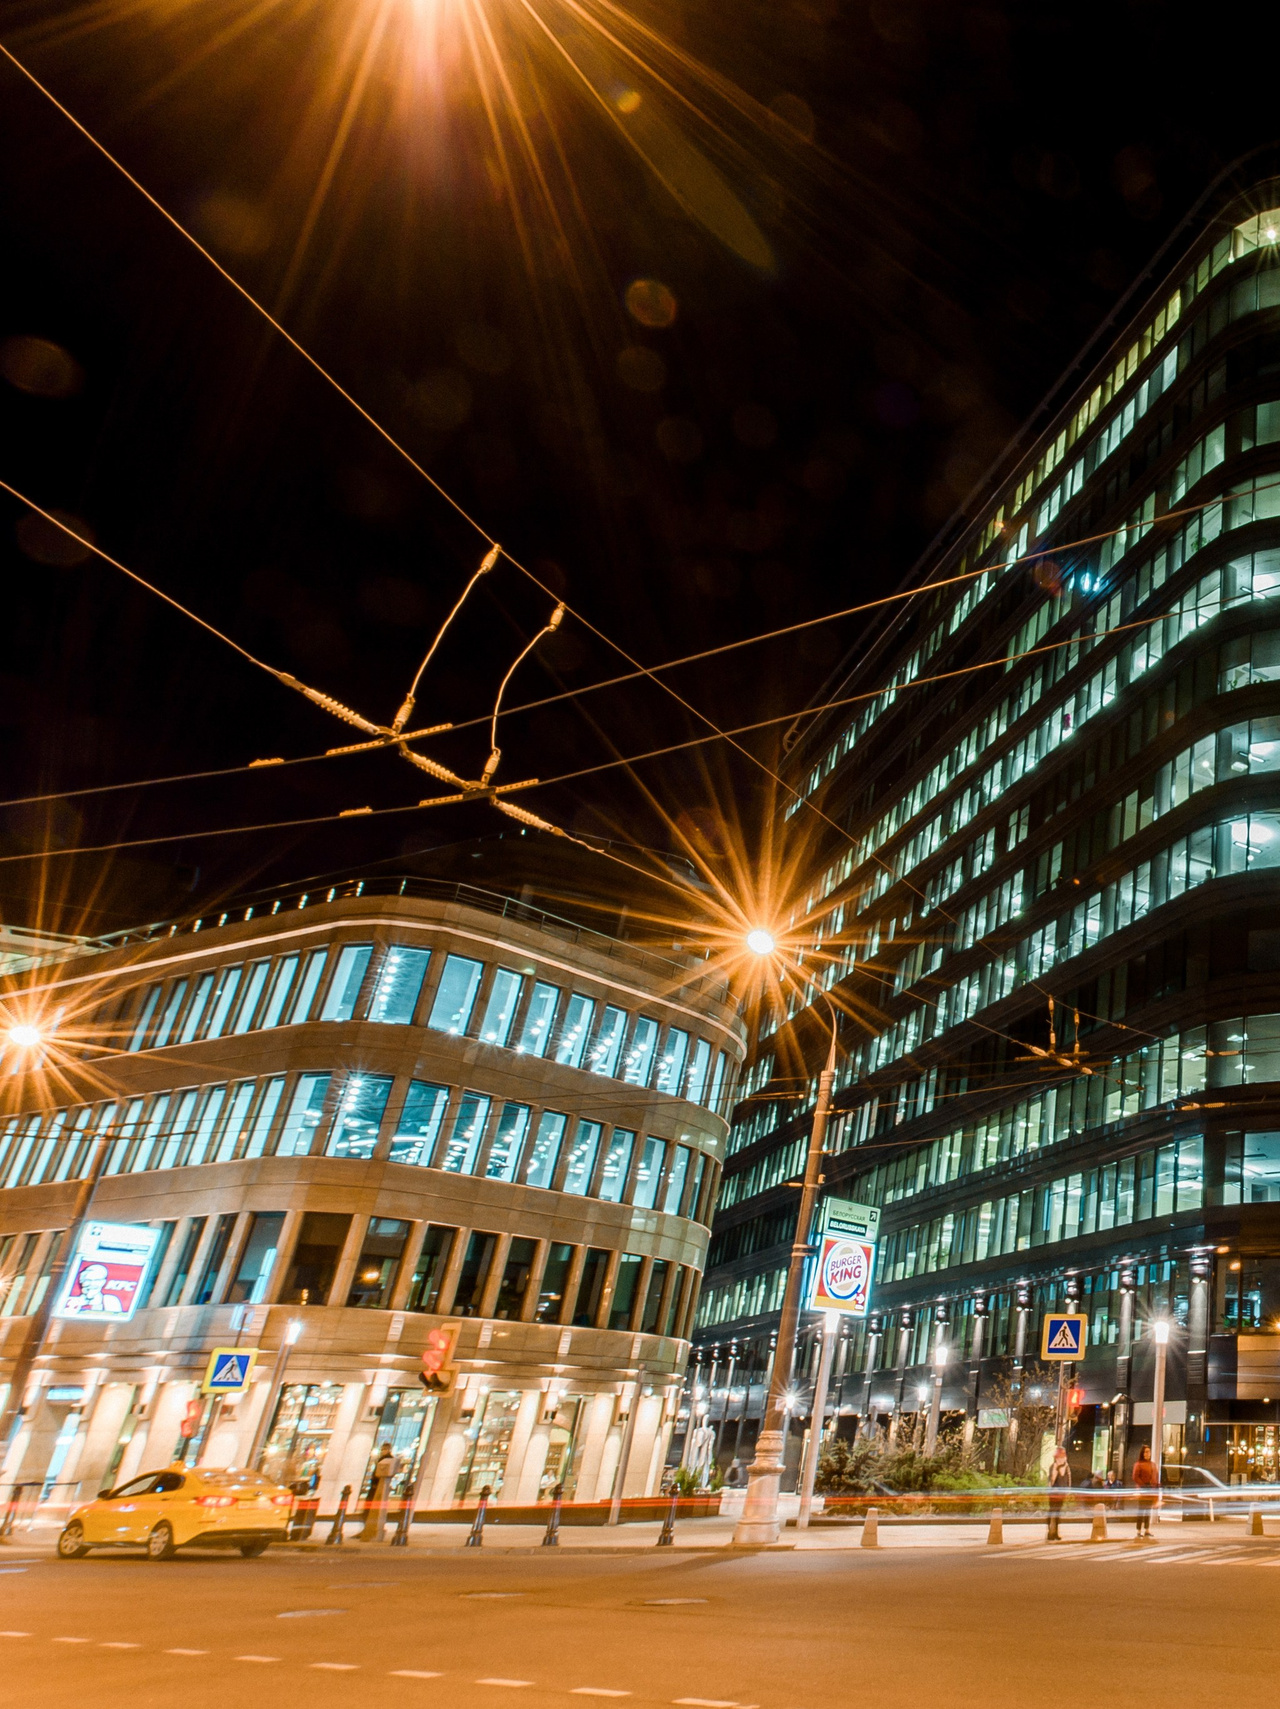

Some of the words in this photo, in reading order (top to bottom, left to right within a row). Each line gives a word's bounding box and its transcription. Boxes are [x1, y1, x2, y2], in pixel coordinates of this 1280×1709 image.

[830, 1255, 862, 1271] BURGER
[830, 1265, 862, 1286] KING
[104, 1279, 138, 1292] KFC
